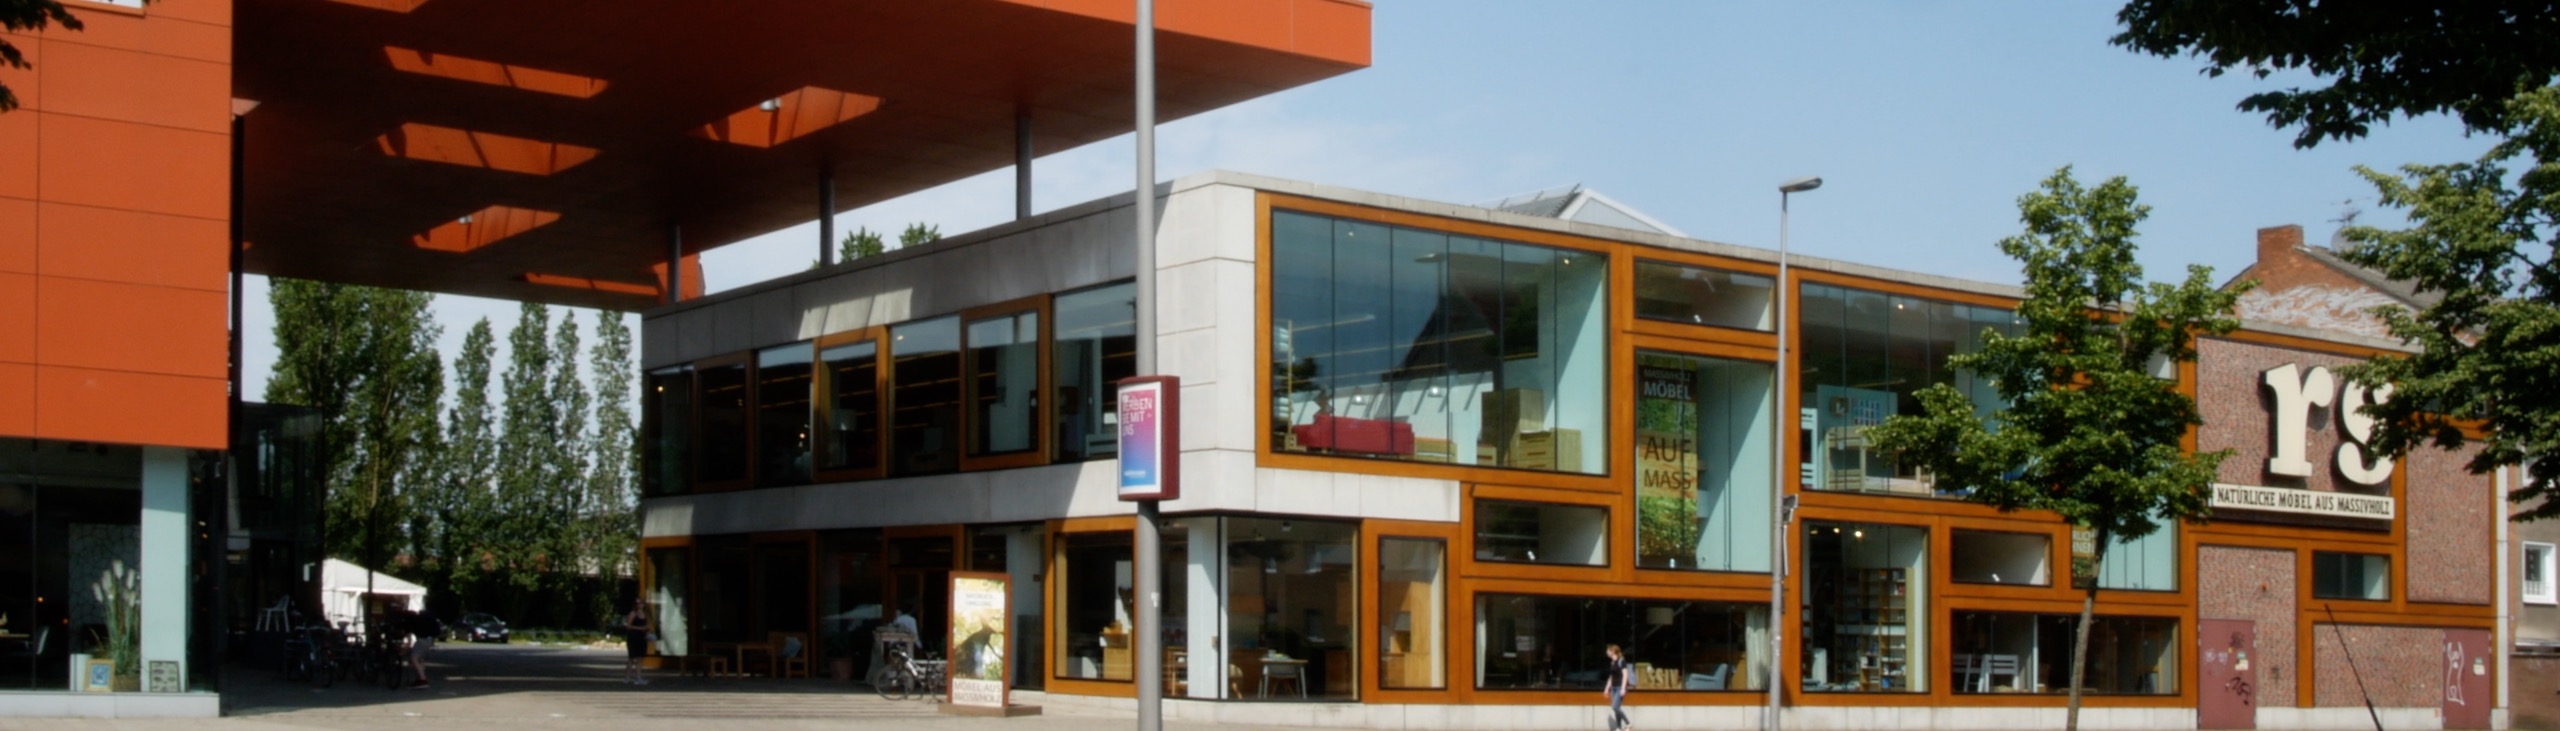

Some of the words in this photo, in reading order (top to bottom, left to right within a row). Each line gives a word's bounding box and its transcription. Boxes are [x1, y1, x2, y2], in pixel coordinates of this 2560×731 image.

[1644, 380, 1692, 400] MÖBEL
[2266, 363, 2395, 485] rs
[1644, 436, 1692, 463] AUF
[1644, 469, 1691, 490] MASS
[2217, 487, 2276, 507] NATÜRLICHE
[2279, 490, 2313, 510] MÖBEL
[2315, 496, 2335, 511] AUS
[2337, 497, 2391, 516] MASSIVHOLZ
